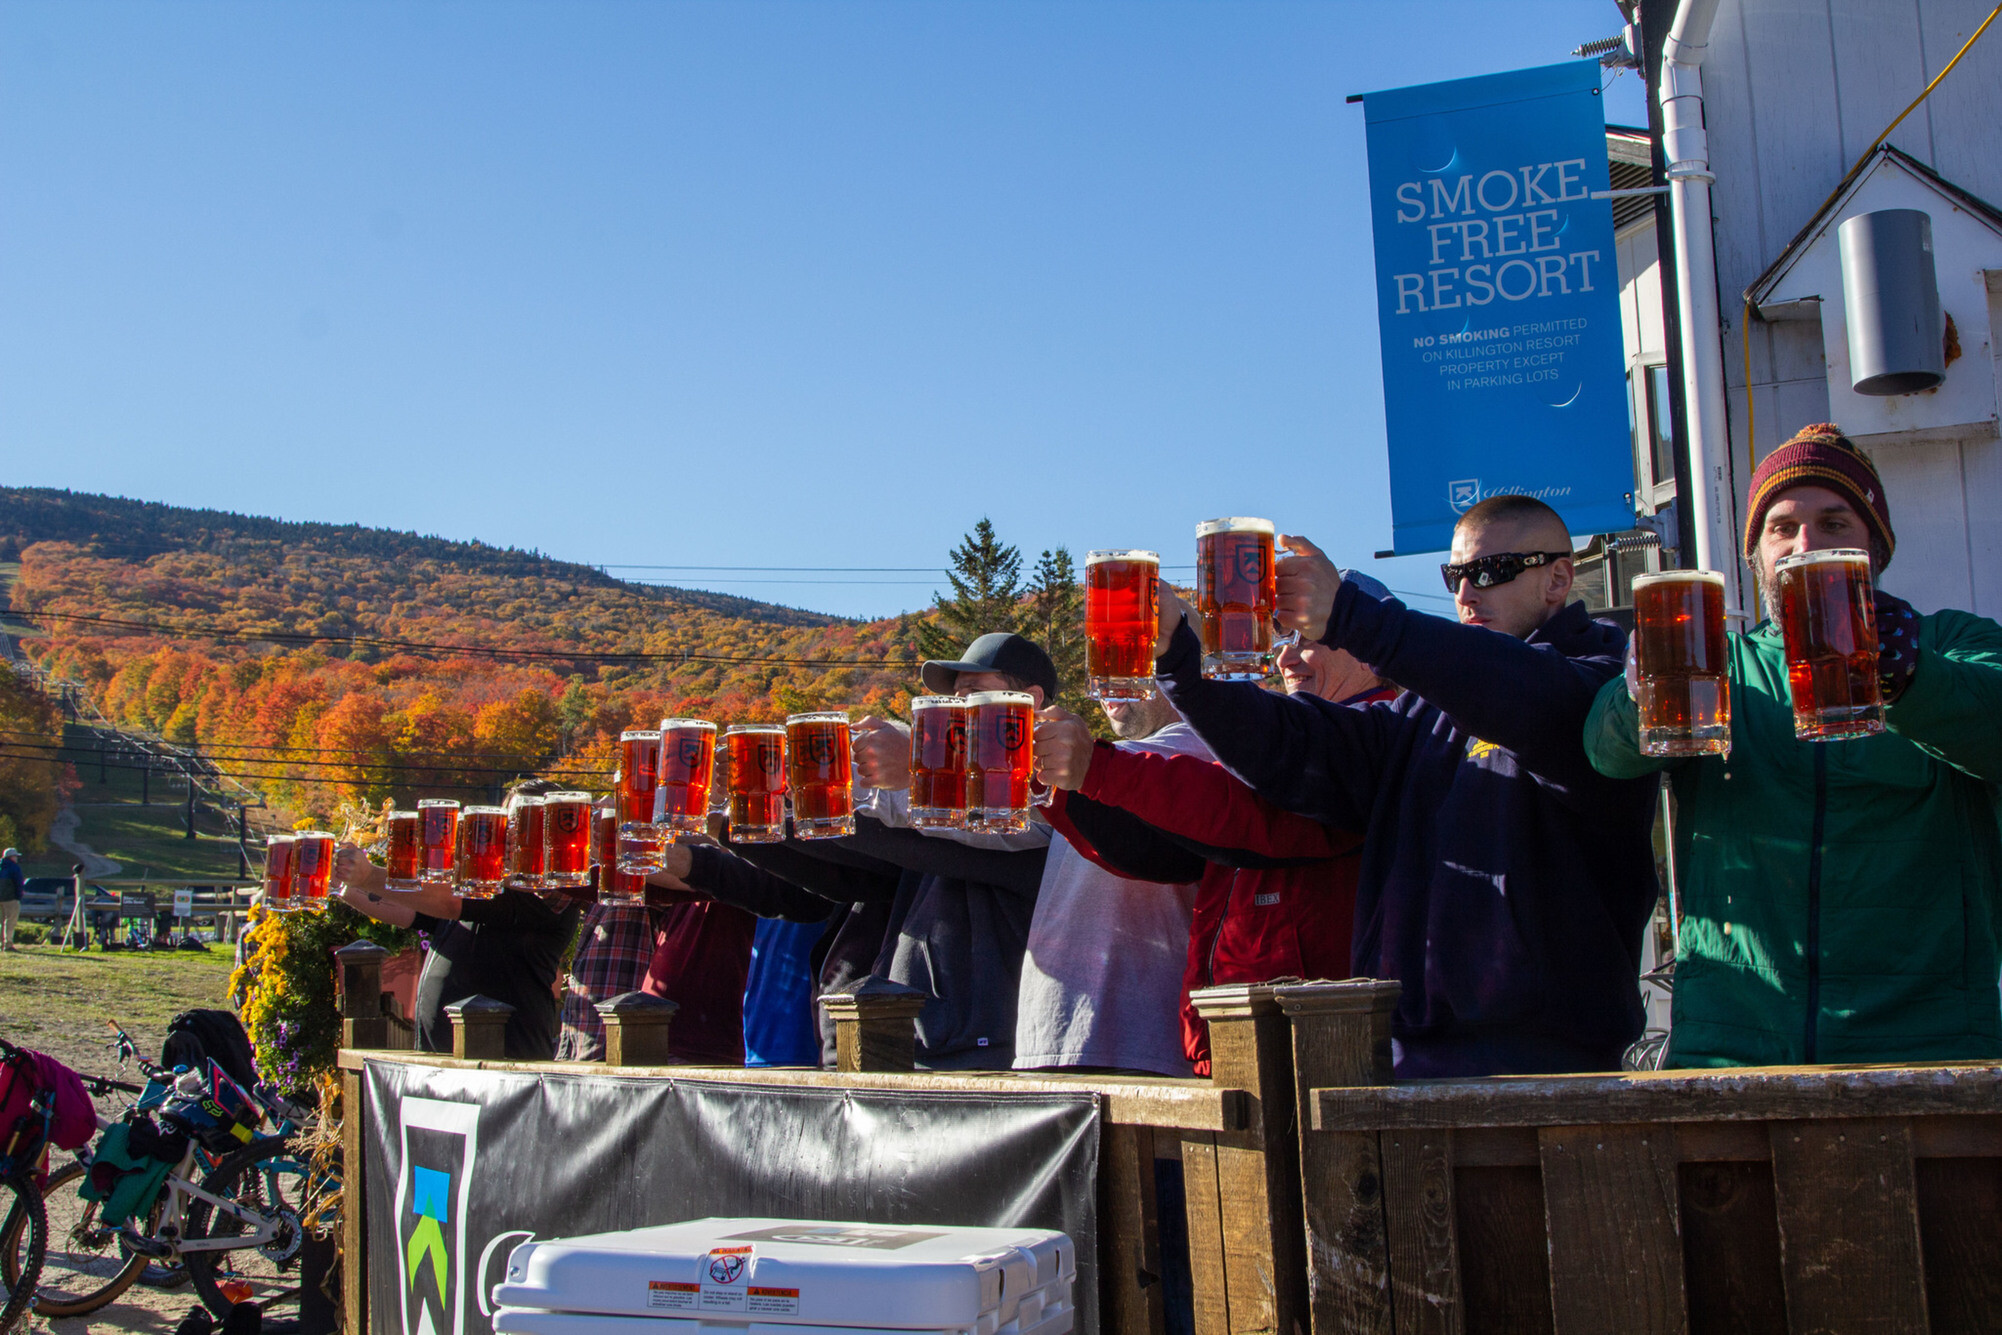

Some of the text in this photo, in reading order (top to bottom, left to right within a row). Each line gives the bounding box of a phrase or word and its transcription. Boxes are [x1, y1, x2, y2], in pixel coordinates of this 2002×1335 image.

[1396, 158, 1588, 223] SMOKE
[1427, 209, 1560, 264] FREE
[1393, 250, 1600, 314] RESORT
[1413, 317, 1588, 348] NO SMOKING PERMITTED
[1422, 334, 1581, 363] ON KILLINGTON RESORT
[1439, 352, 1565, 376] PROPERTY EXCEPT
[1448, 368, 1559, 391] IN PARKING LOTS
[1255, 893, 1280, 905] IBEX
